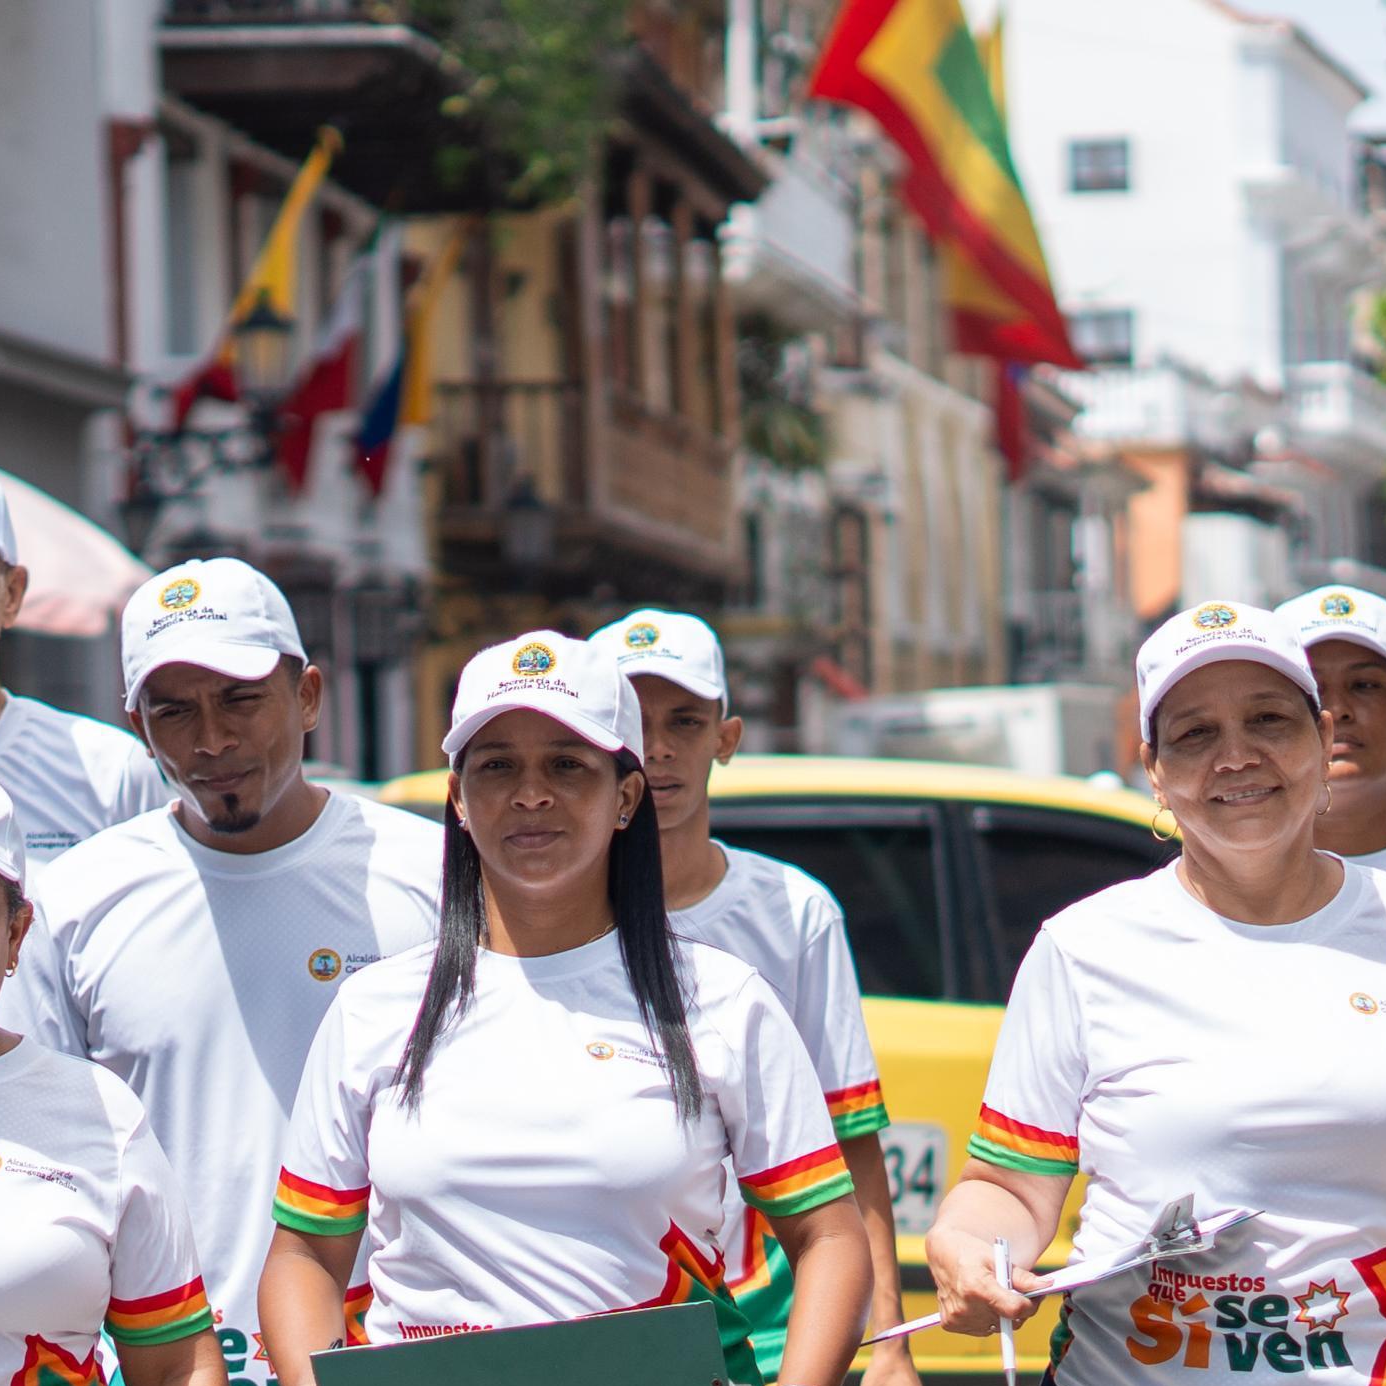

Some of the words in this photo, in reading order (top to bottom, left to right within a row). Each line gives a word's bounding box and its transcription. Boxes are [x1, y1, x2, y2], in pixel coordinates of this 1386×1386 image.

[554, 679, 566, 687] de
[1147, 1280, 1186, 1304] que
[1150, 1260, 1266, 1293] Impuestos
[1125, 1291, 1212, 1369] Sí
[1213, 1294, 1290, 1330] se
[1223, 1330, 1354, 1374] ven
